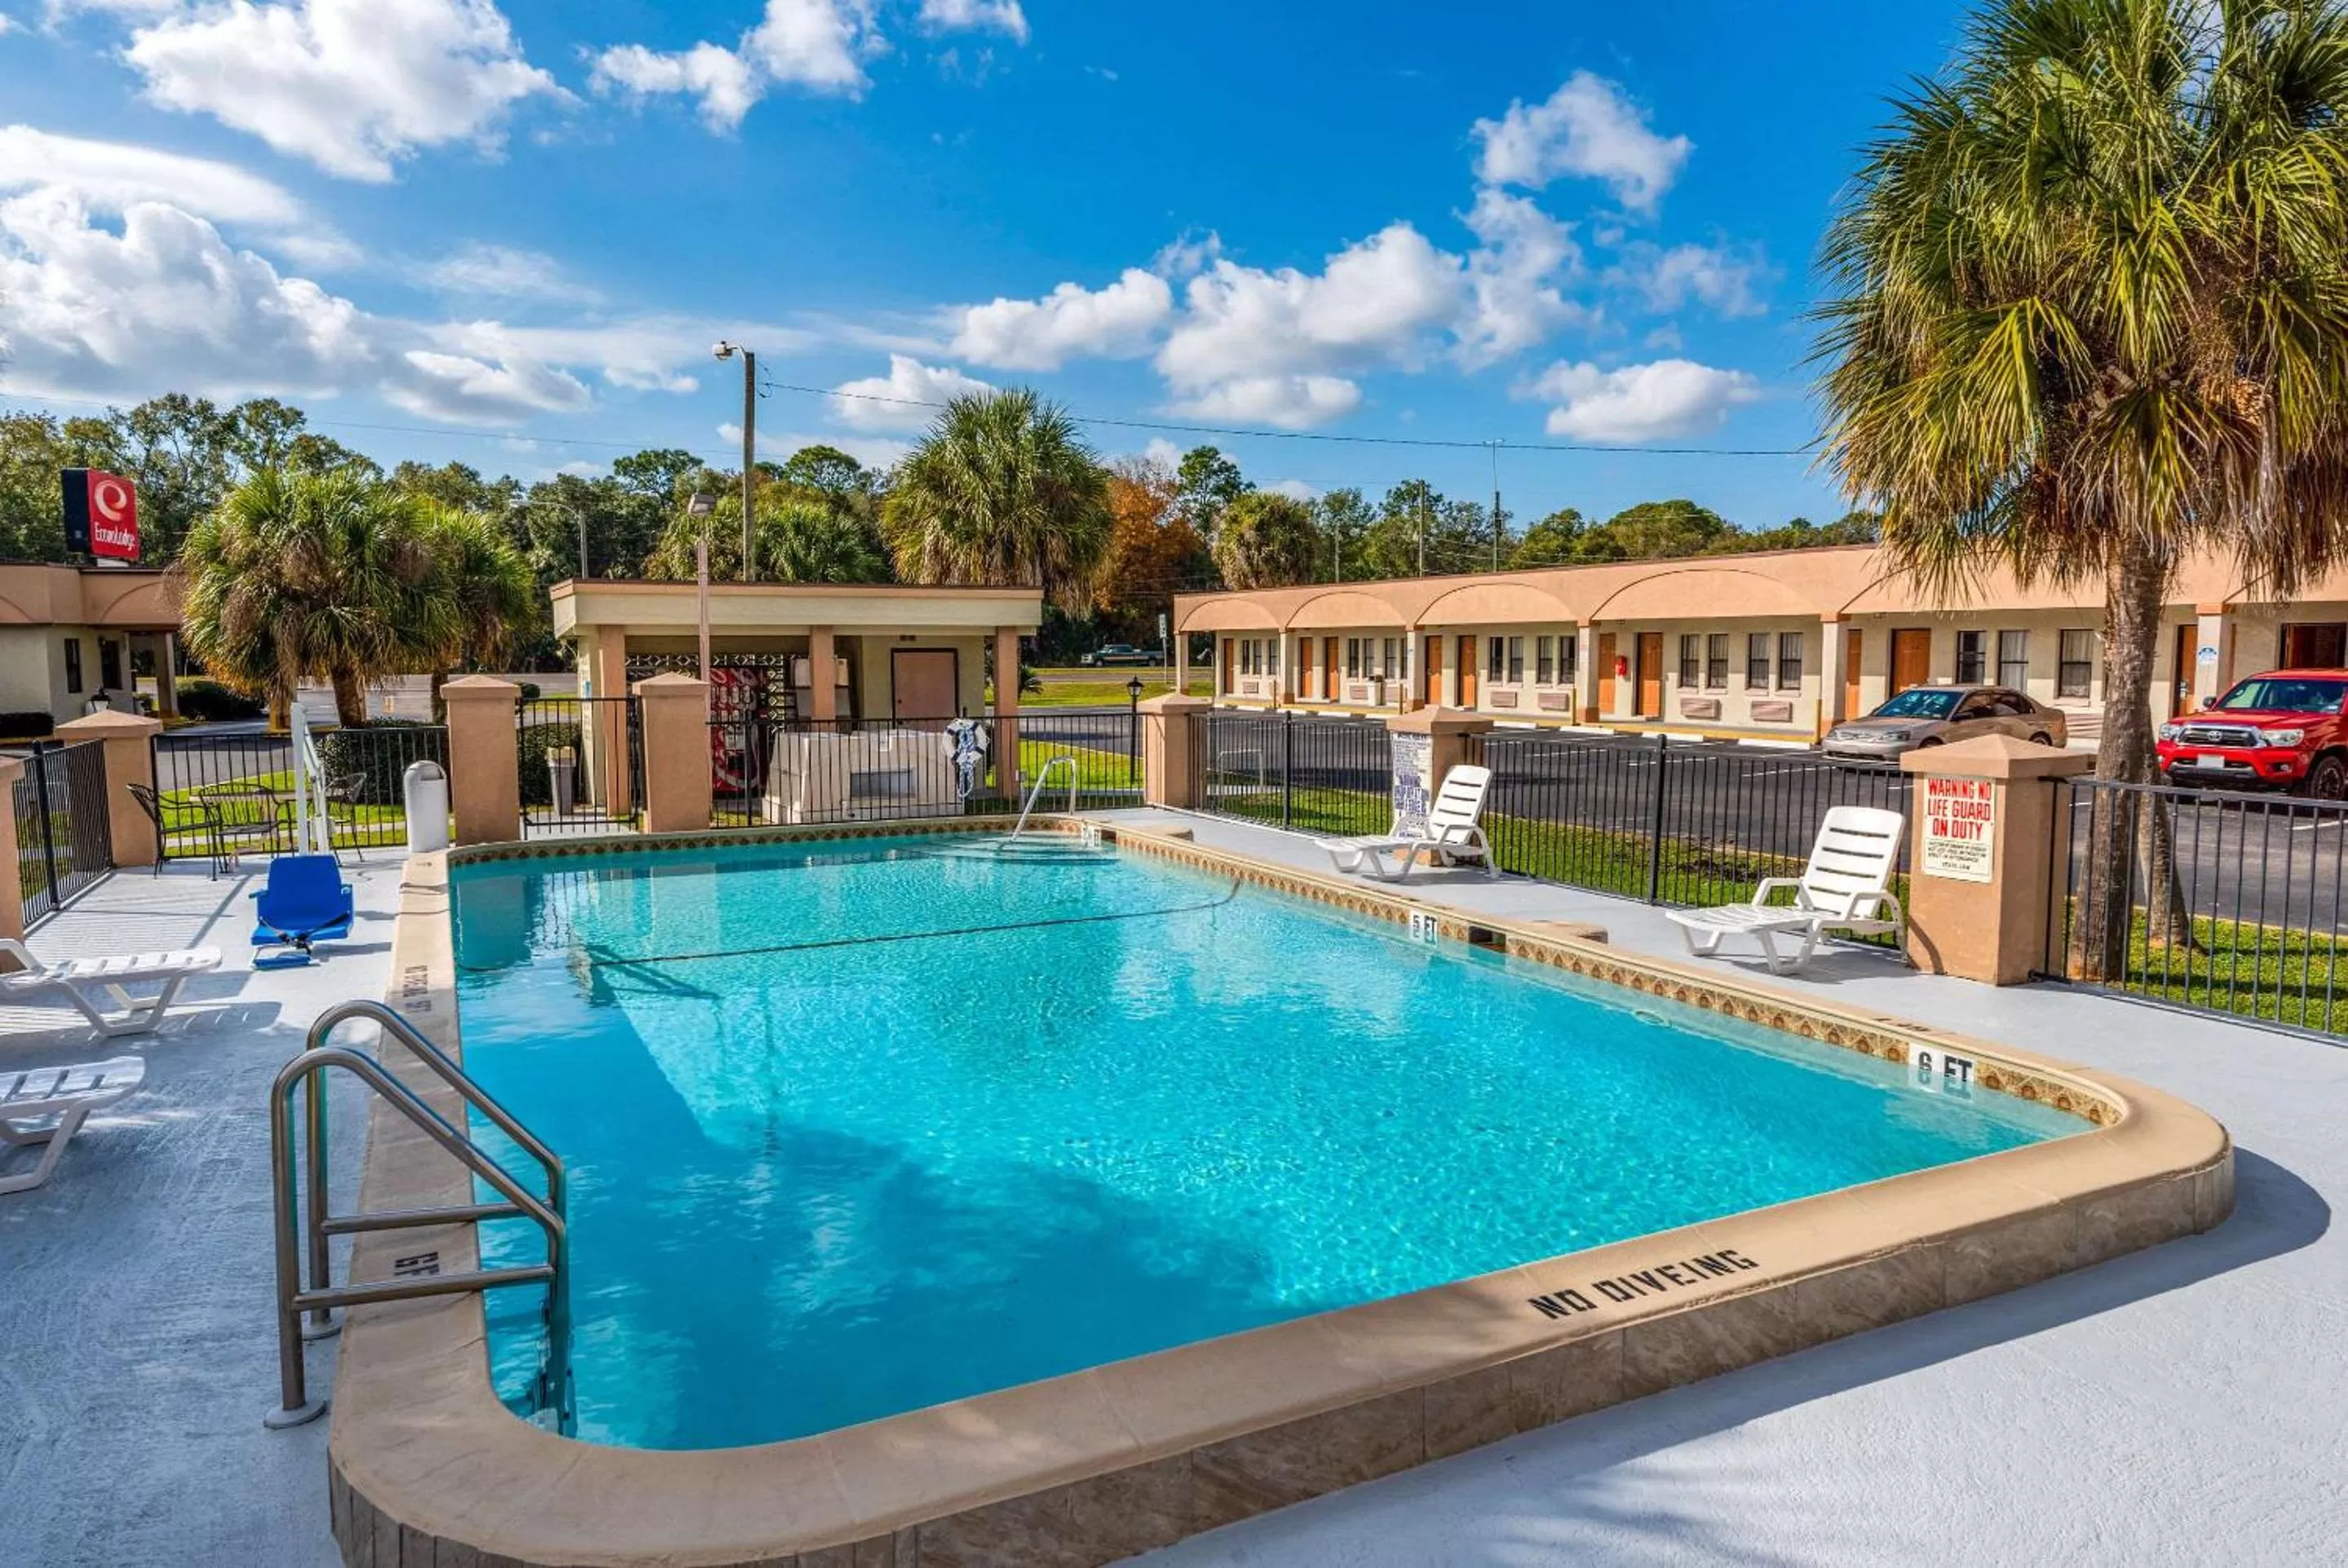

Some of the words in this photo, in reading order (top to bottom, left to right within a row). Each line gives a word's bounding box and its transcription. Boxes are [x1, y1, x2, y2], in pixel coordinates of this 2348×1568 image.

[1928, 778, 1974, 799] WARNING
[1978, 781, 1991, 801] NO
[1927, 798, 1948, 817] LIFE
[1952, 800, 1991, 821] GUARD
[1933, 818, 1948, 837] ON
[1952, 819, 1983, 841] DUTY
[1943, 1053, 1973, 1082] FT
[1528, 1288, 1597, 1319] NO
[1591, 1249, 1759, 1303] DIVEING
